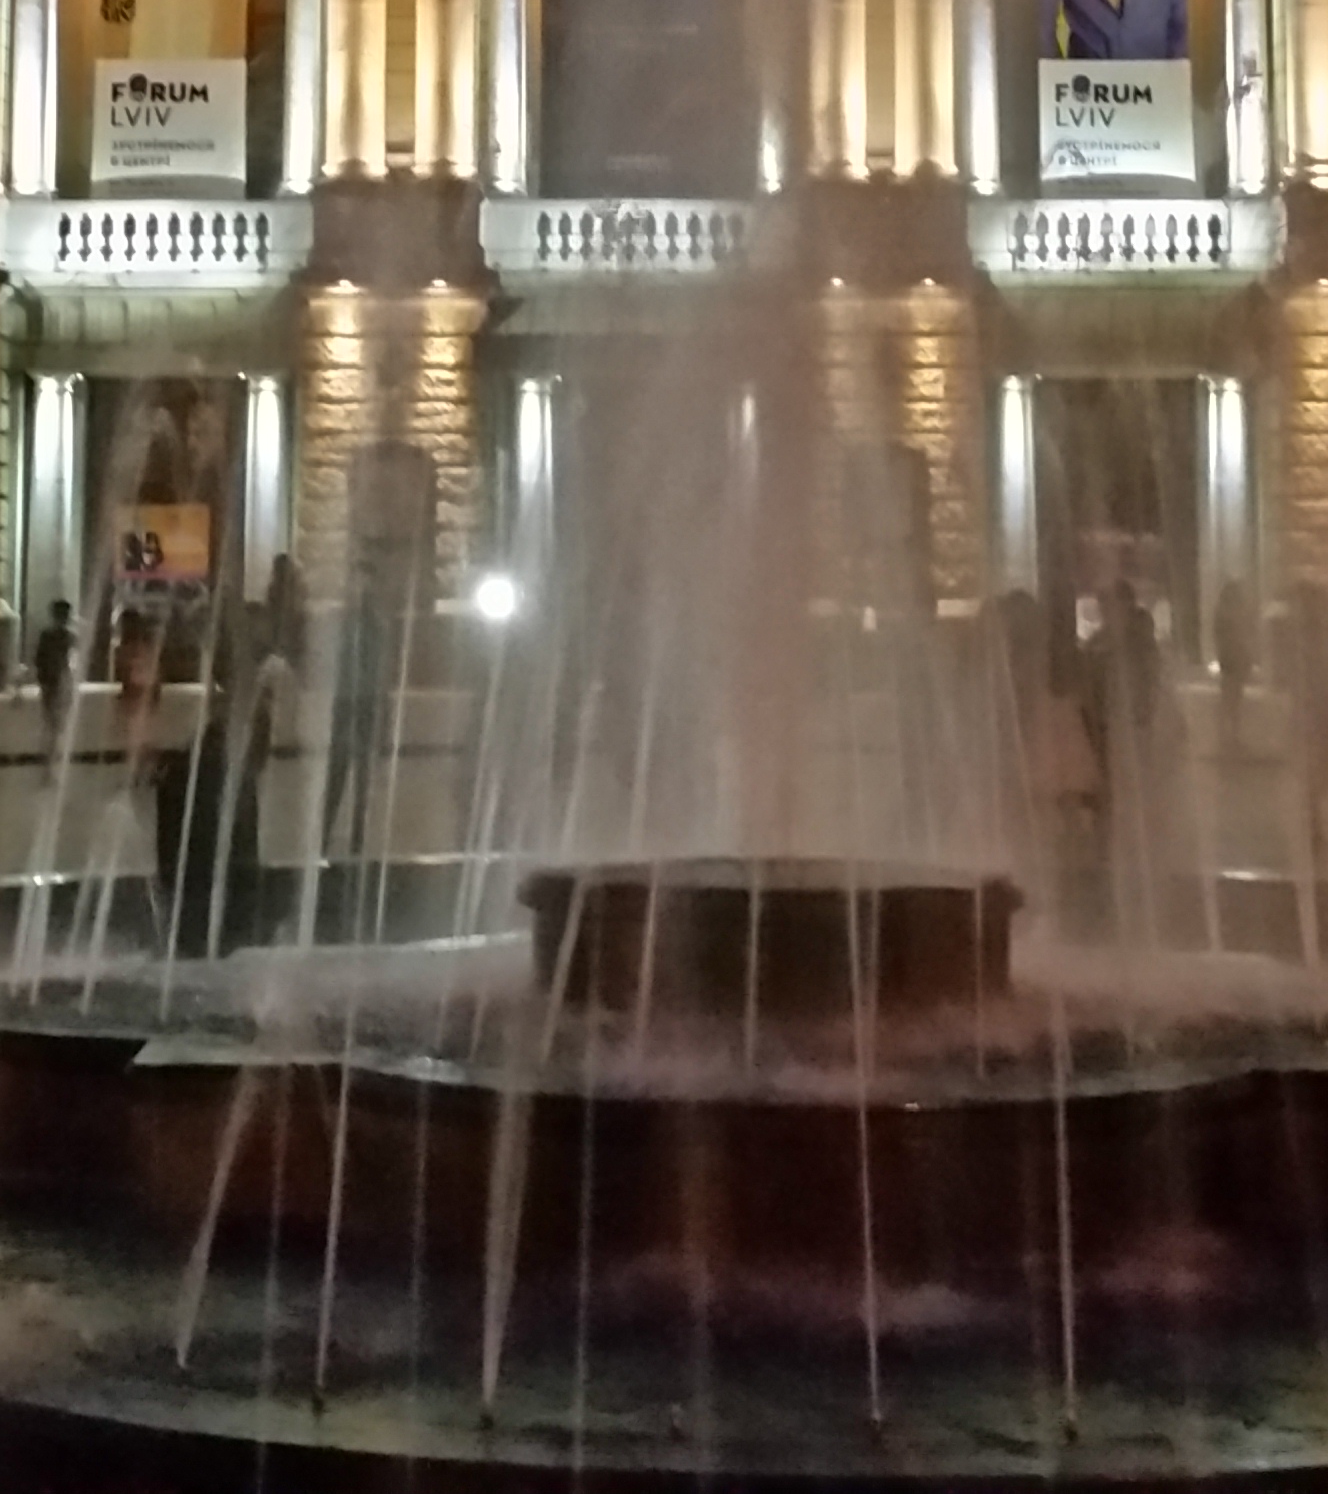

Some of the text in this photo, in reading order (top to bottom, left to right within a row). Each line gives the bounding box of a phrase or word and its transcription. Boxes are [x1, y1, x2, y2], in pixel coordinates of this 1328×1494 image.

[110, 73, 210, 103] FORUM
[1054, 73, 1153, 104] FORUM
[110, 105, 171, 128] LVIV
[1055, 105, 1116, 128] LVIV
